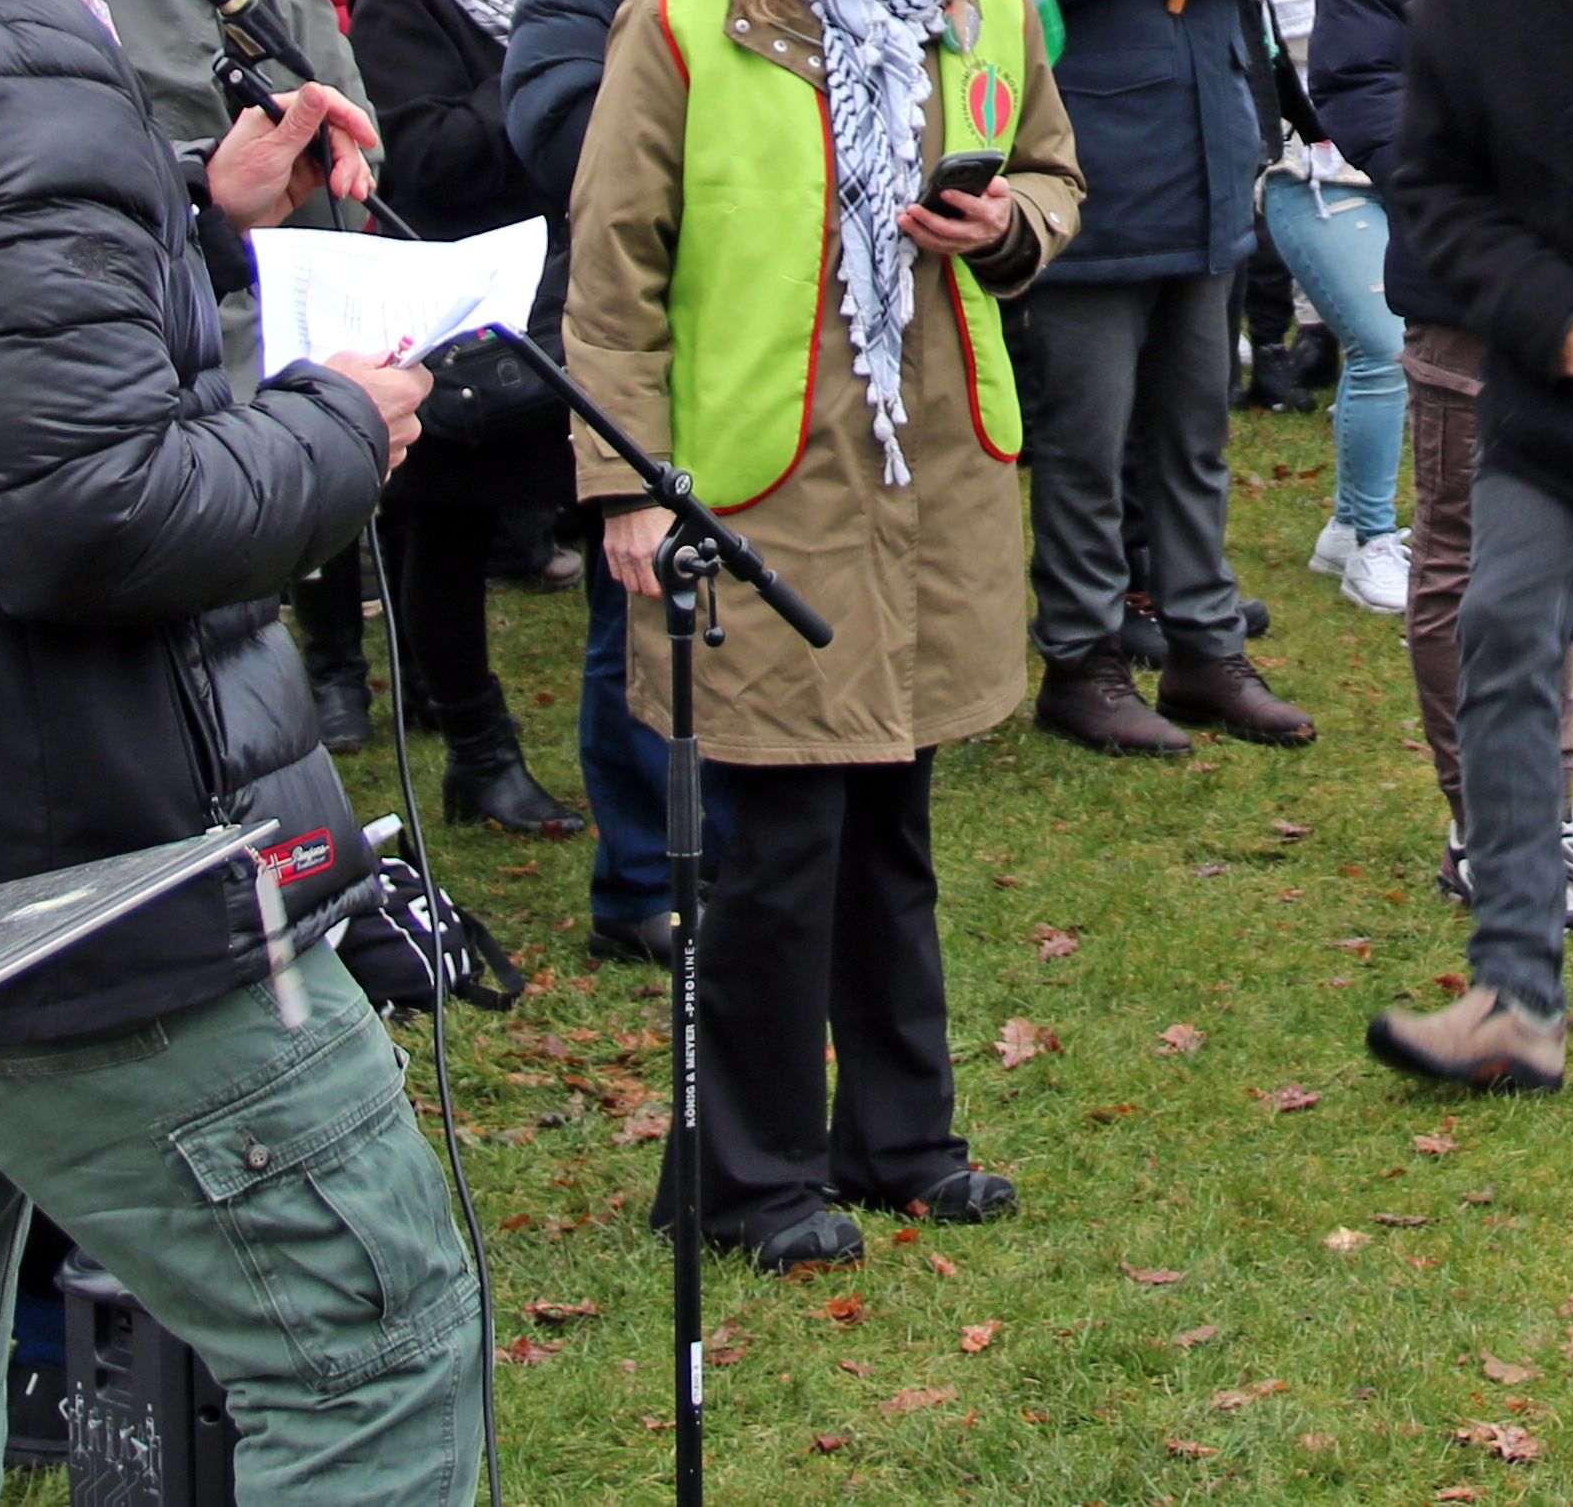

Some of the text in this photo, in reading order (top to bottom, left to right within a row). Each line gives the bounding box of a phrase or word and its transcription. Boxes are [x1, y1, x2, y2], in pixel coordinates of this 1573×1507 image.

[685, 1024, 696, 1070] MEYER
[685, 1072, 696, 1083] &
[684, 1085, 696, 1127] KÖNIG
